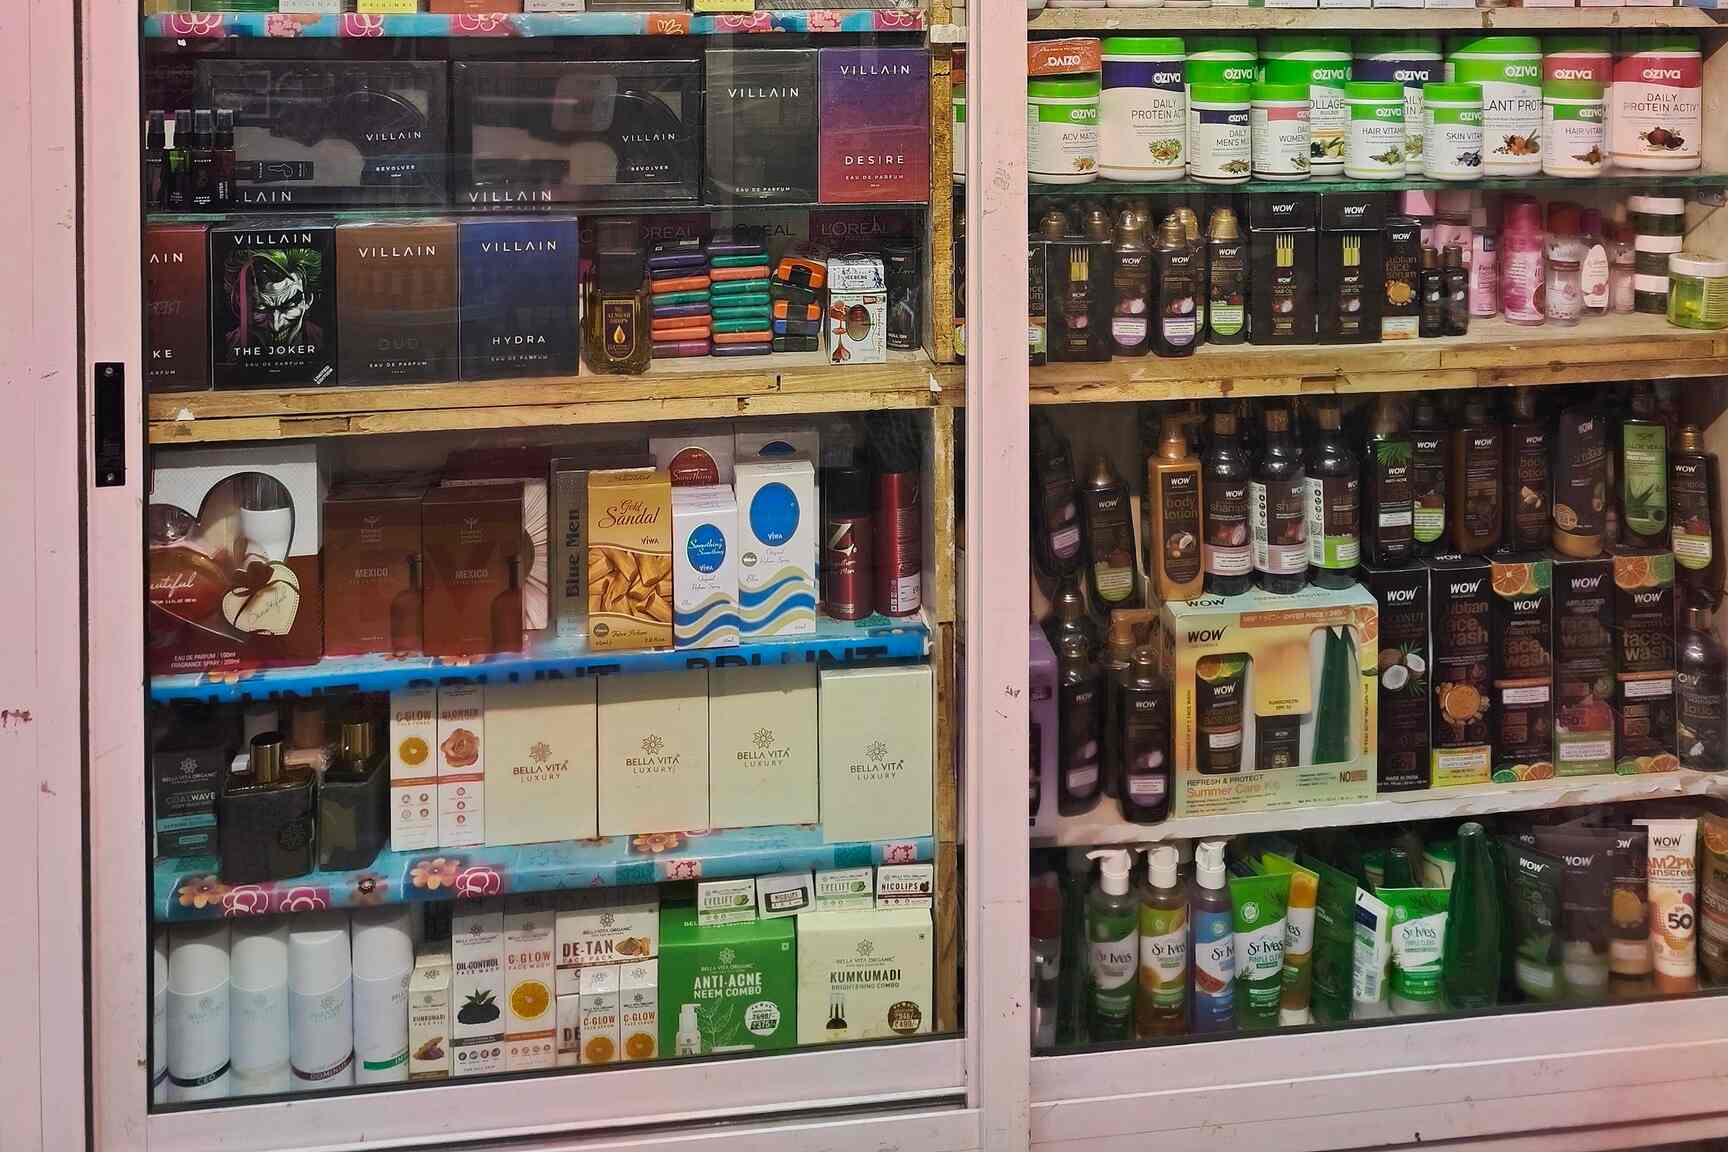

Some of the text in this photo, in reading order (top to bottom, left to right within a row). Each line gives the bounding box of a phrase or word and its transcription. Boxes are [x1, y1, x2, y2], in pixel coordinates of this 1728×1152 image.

[841, 65, 910, 75] VILLAIN
[728, 88, 800, 98] VILLAIN
[1647, 94, 1676, 102] DAILY
[1154, 100, 1176, 109] DAILY
[1624, 102, 1669, 112] PROTEIN
[1132, 109, 1172, 120] PROTEIN
[366, 131, 422, 140] VILLAIN
[623, 133, 675, 143] VILLAIN
[845, 155, 904, 165] DESIRE
[469, 191, 551, 203] VILLAIN
[1273, 203, 1295, 213] WOW
[1344, 204, 1366, 214] WOW
[235, 233, 312, 244] VILLAIN
[1392, 232, 1412, 240] WOW
[359, 246, 436, 258] VILLAIN
[482, 241, 557, 252] VILLAIN
[1219, 247, 1238, 255] WOW
[1122, 255, 1142, 264] WOW
[1172, 255, 1191, 263] WOW
[493, 335, 546, 345] HYDRA
[235, 345, 315, 356] THE JOKER
[1417, 440, 1438, 448] WOW
[1474, 438, 1493, 446] WOW
[1675, 464, 1696, 472] WOW
[1171, 475, 1191, 485] WOW
[1226, 490, 1244, 498] WOW
[620, 499, 642, 513] Gold
[1099, 499, 1118, 507] WOW
[599, 508, 661, 528] Sandal
[566, 509, 579, 597] Blue Men
[355, 568, 388, 579] MEXICO
[455, 570, 488, 580] MEXICO
[1451, 580, 1482, 593] WOW
[1571, 576, 1603, 588] WOW
[1387, 587, 1418, 600] WOW
[1634, 592, 1664, 603] WOW
[1185, 598, 1225, 608] WOW
[1513, 598, 1543, 610] WOW
[1188, 627, 1226, 642] WOW
[1214, 683, 1237, 695] WOW
[396, 711, 431, 722] C-GLOW
[737, 748, 790, 760] BELLA VITA
[625, 754, 679, 767] BELLA VITA
[744, 759, 783, 768] LUXURY
[513, 762, 567, 775] BELLA VITA
[633, 766, 672, 775] LUXURY
[850, 761, 903, 774] BELLA VITA
[520, 773, 561, 782] LUXURY
[858, 772, 896, 780] LUXURY
[1229, 774, 1263, 783] PROTECT
[1340, 772, 1350, 781] NO
[1187, 787, 1232, 798] Summer
[1653, 837, 1682, 847] WOW
[1520, 858, 1549, 871] WOW
[881, 882, 918, 892] NICOLIPS
[1668, 912, 1692, 929] 50
[563, 940, 614, 957] DE-TAN
[508, 952, 551, 964] C-GLOW
[457, 959, 499, 970] OIL-CONTROL
[830, 969, 900, 982] KUMKUMADI
[694, 974, 762, 989] ANTI-ACNE
[694, 986, 762, 998] NEEM COMBO
[584, 1015, 615, 1026] C-GLOW
[624, 1012, 655, 1023] C-GLOW
